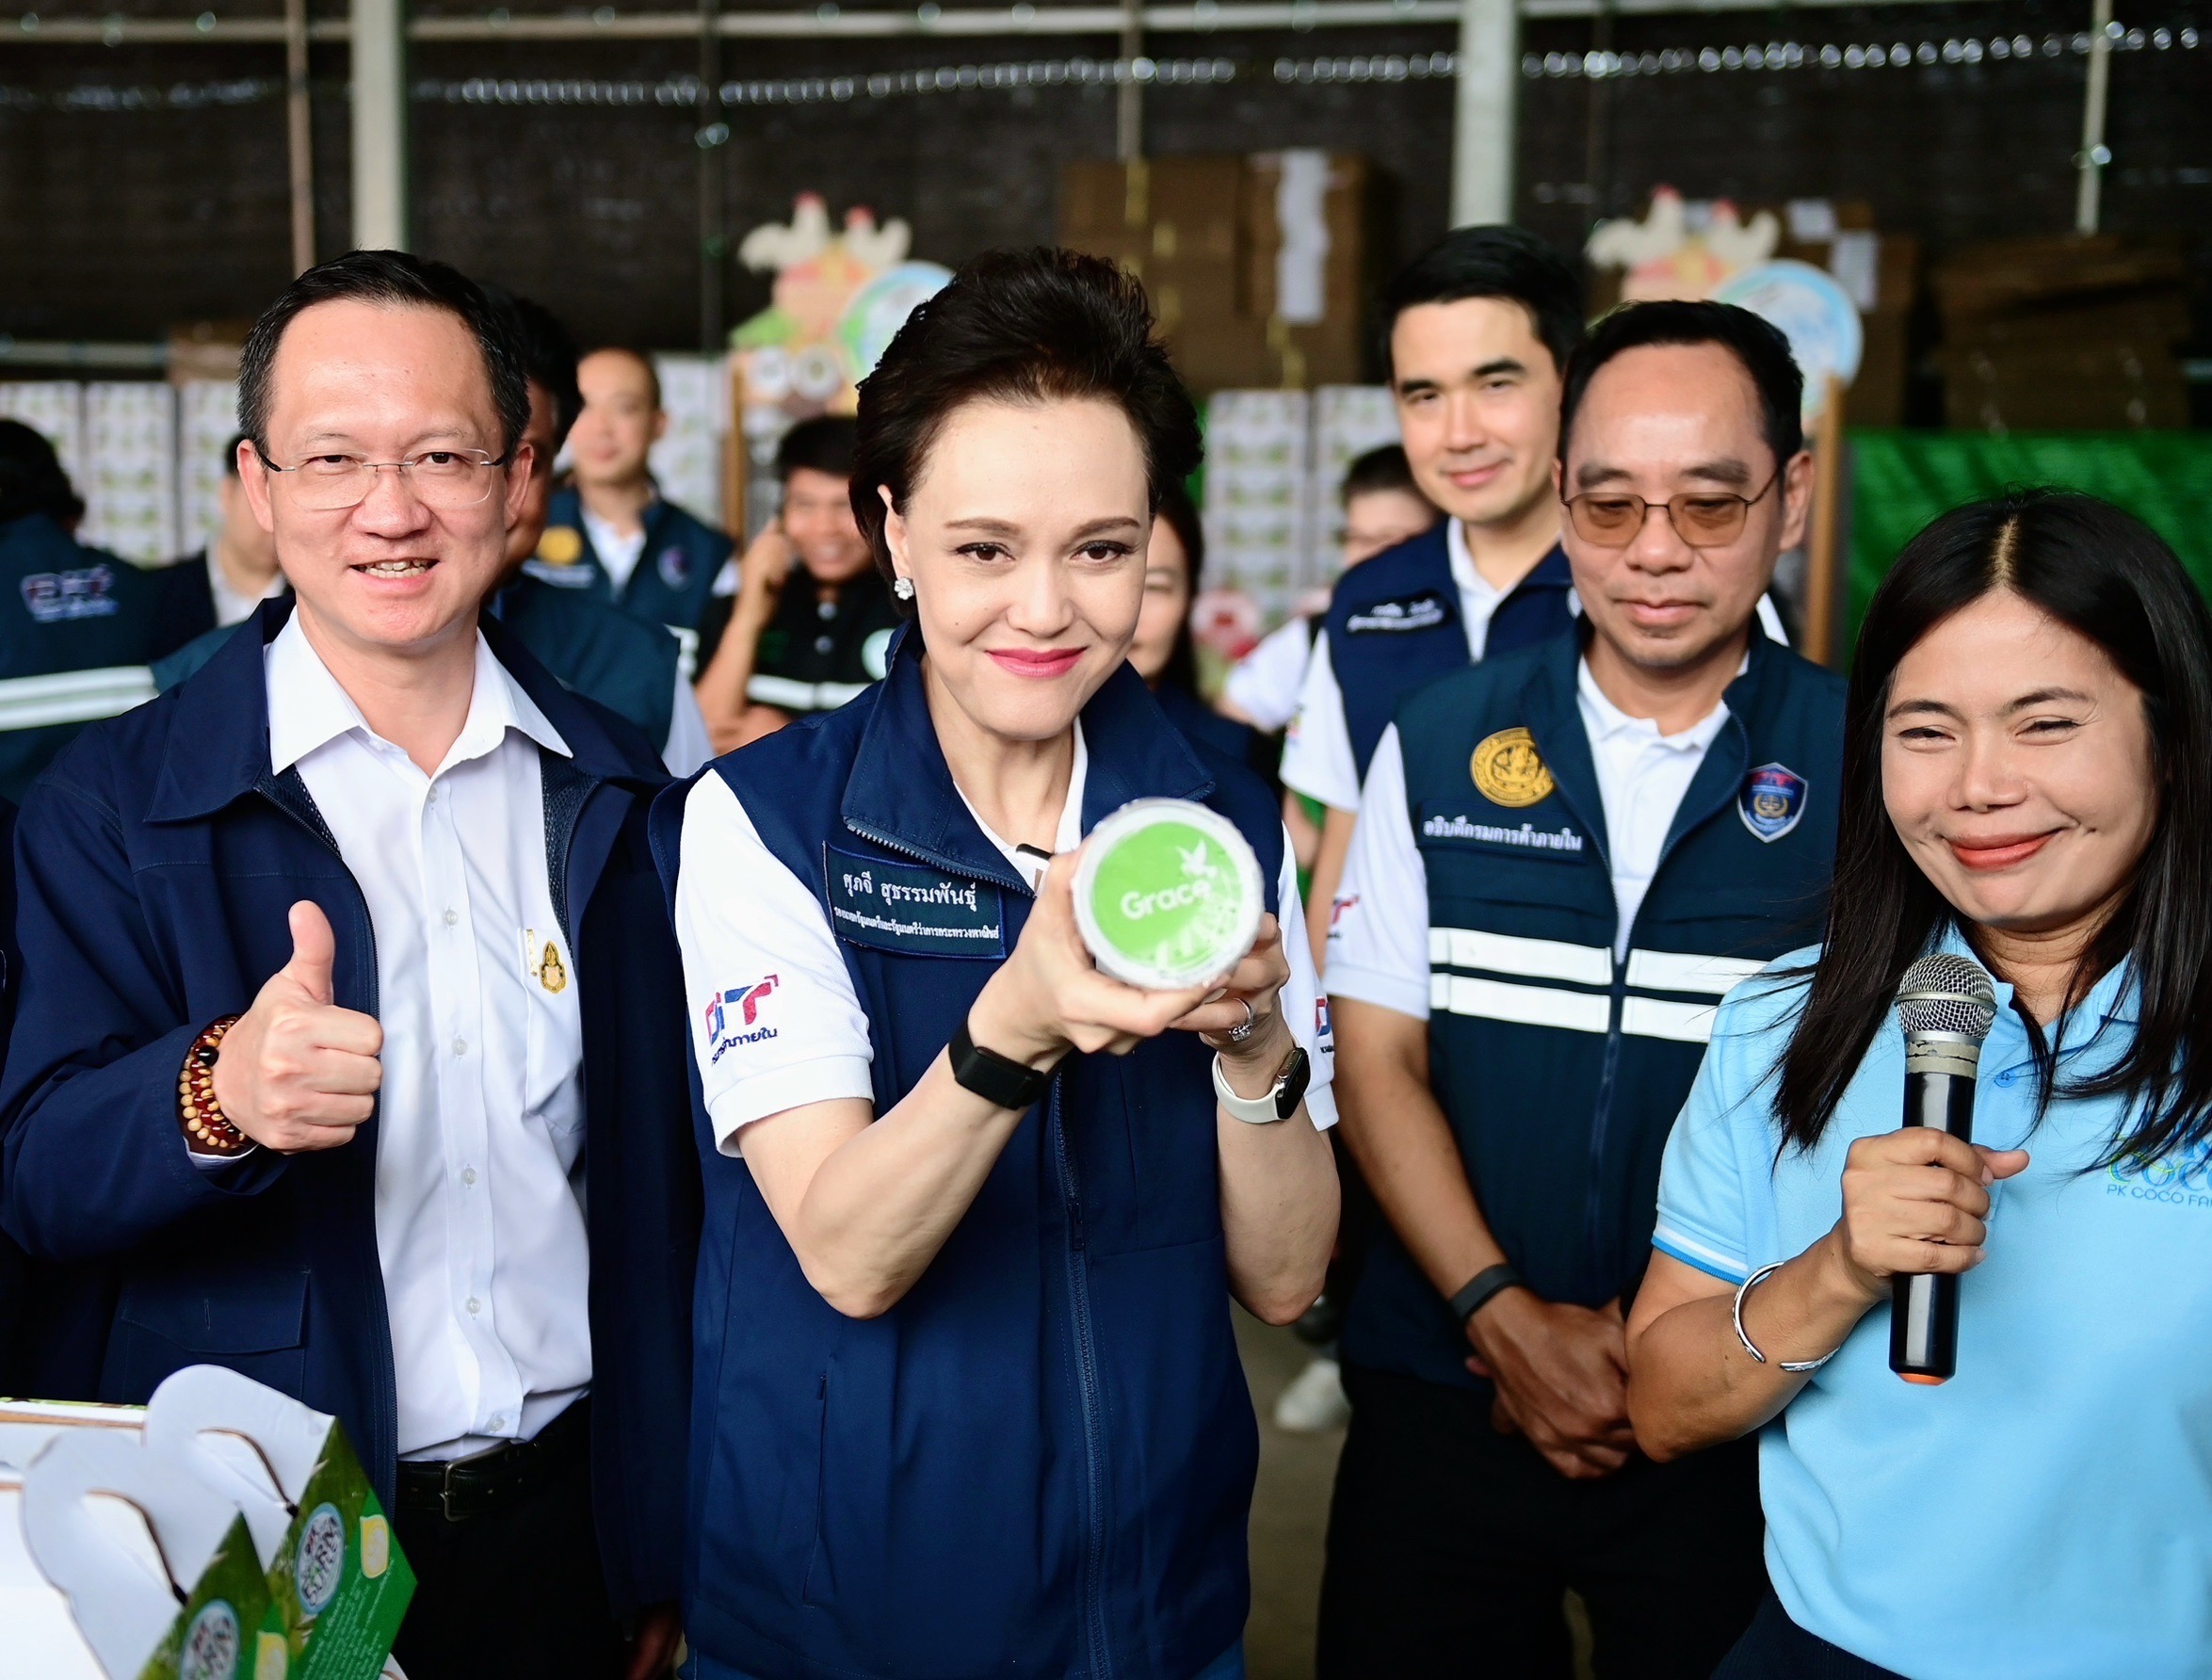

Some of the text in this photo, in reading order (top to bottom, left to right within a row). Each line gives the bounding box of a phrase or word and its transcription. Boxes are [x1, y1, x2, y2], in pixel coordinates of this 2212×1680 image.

[1423, 815, 1582, 850] อธิบดีกรมการค้าภายใน
[843, 871, 977, 912] ศุภจี สุธรรมพันธุ์
[1120, 880, 1211, 920] Grace
[2107, 1184, 2212, 1208] PK COCO FA
